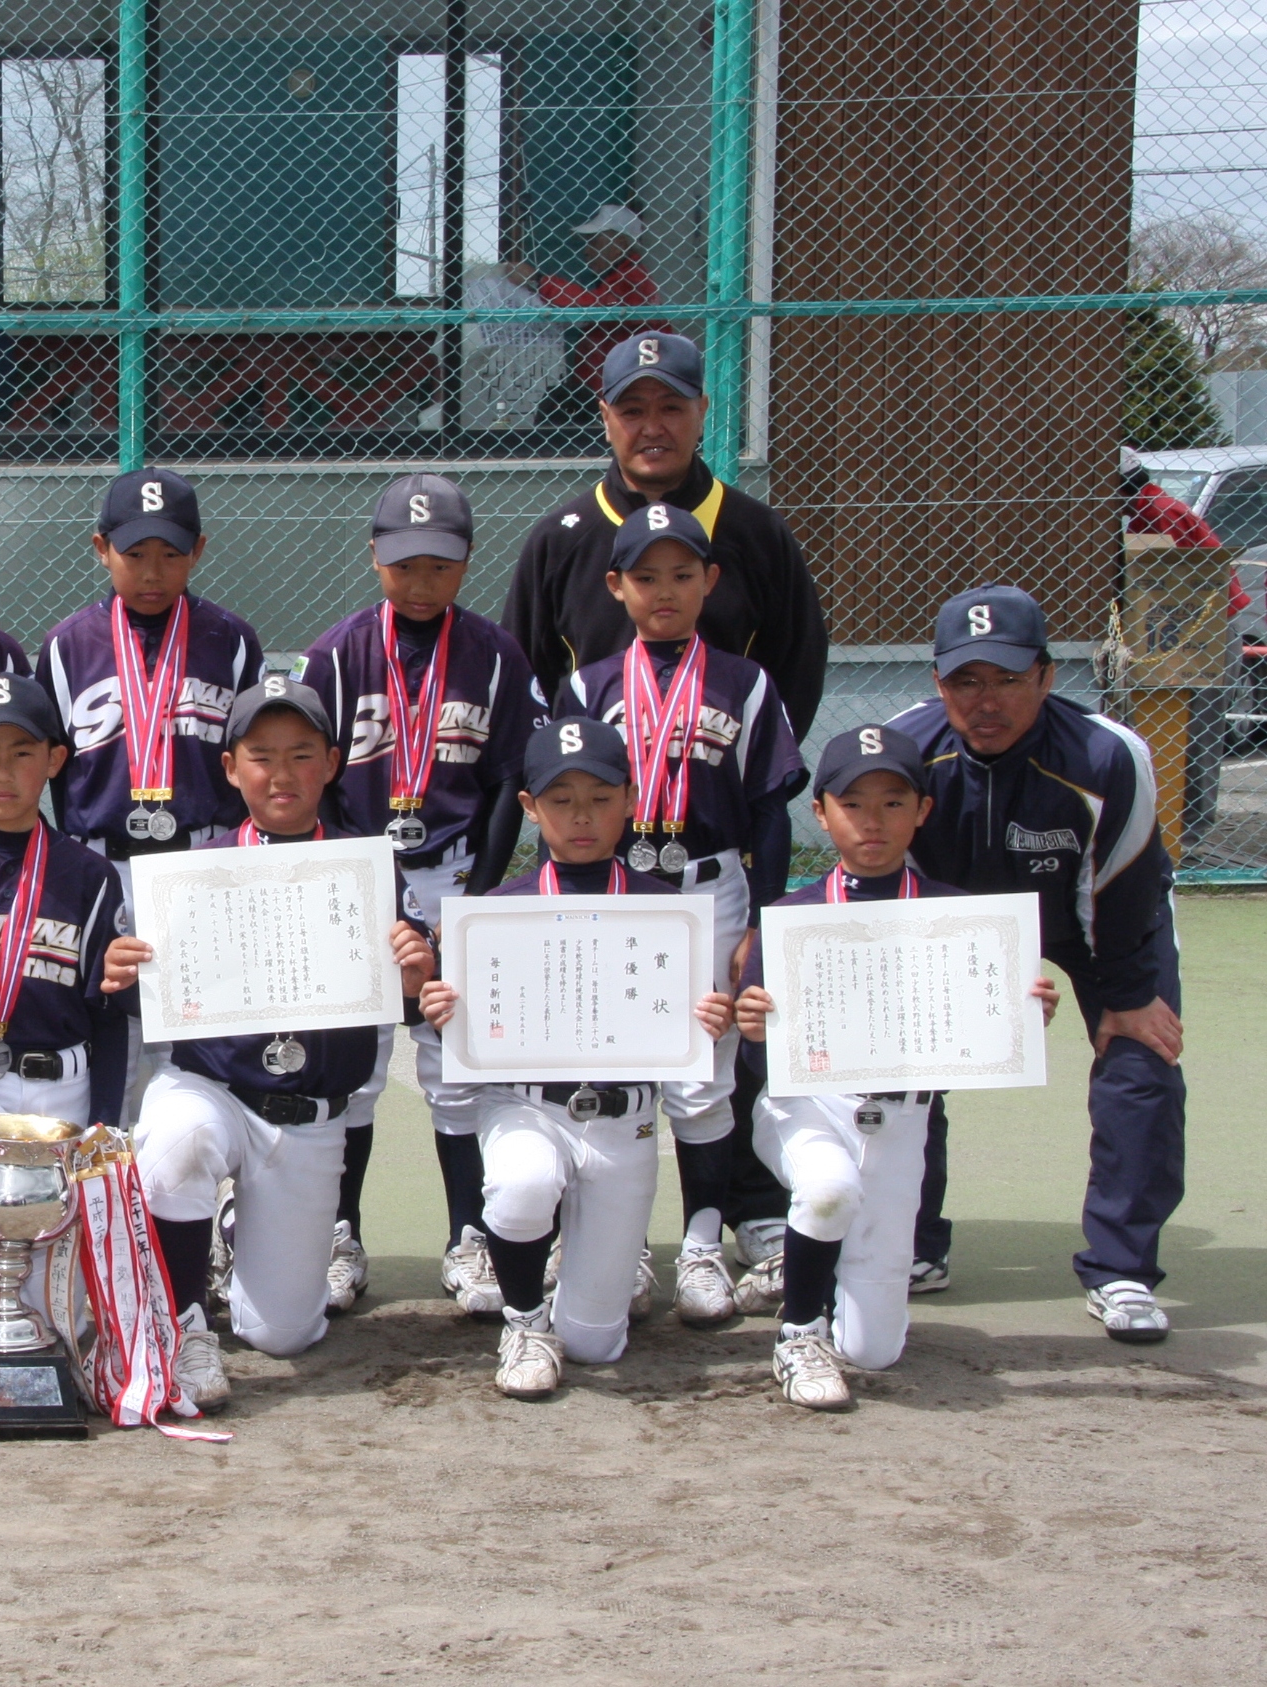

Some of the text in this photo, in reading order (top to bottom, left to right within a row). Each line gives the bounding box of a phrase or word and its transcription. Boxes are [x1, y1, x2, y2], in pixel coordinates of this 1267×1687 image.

[638, 339, 659, 366] S
[141, 481, 164, 513] S
[410, 494, 431, 524] S
[647, 505, 670, 531] S
[968, 604, 992, 637] S
[263, 676, 287, 698] S
[559, 723, 584, 754] S
[859, 728, 883, 756] S
[1028, 856, 1060, 874] 29
[327, 882, 343, 926] 準優勝
[345, 901, 364, 963] 表彰状
[623, 936, 639, 1001] 準優勝
[965, 941, 980, 979] 準優勝
[314, 983, 328, 995] 殿
[488, 956, 502, 1031] 毎日新聞社
[983, 961, 1002, 1017] 表彰状
[958, 1048, 973, 1060] 殿
